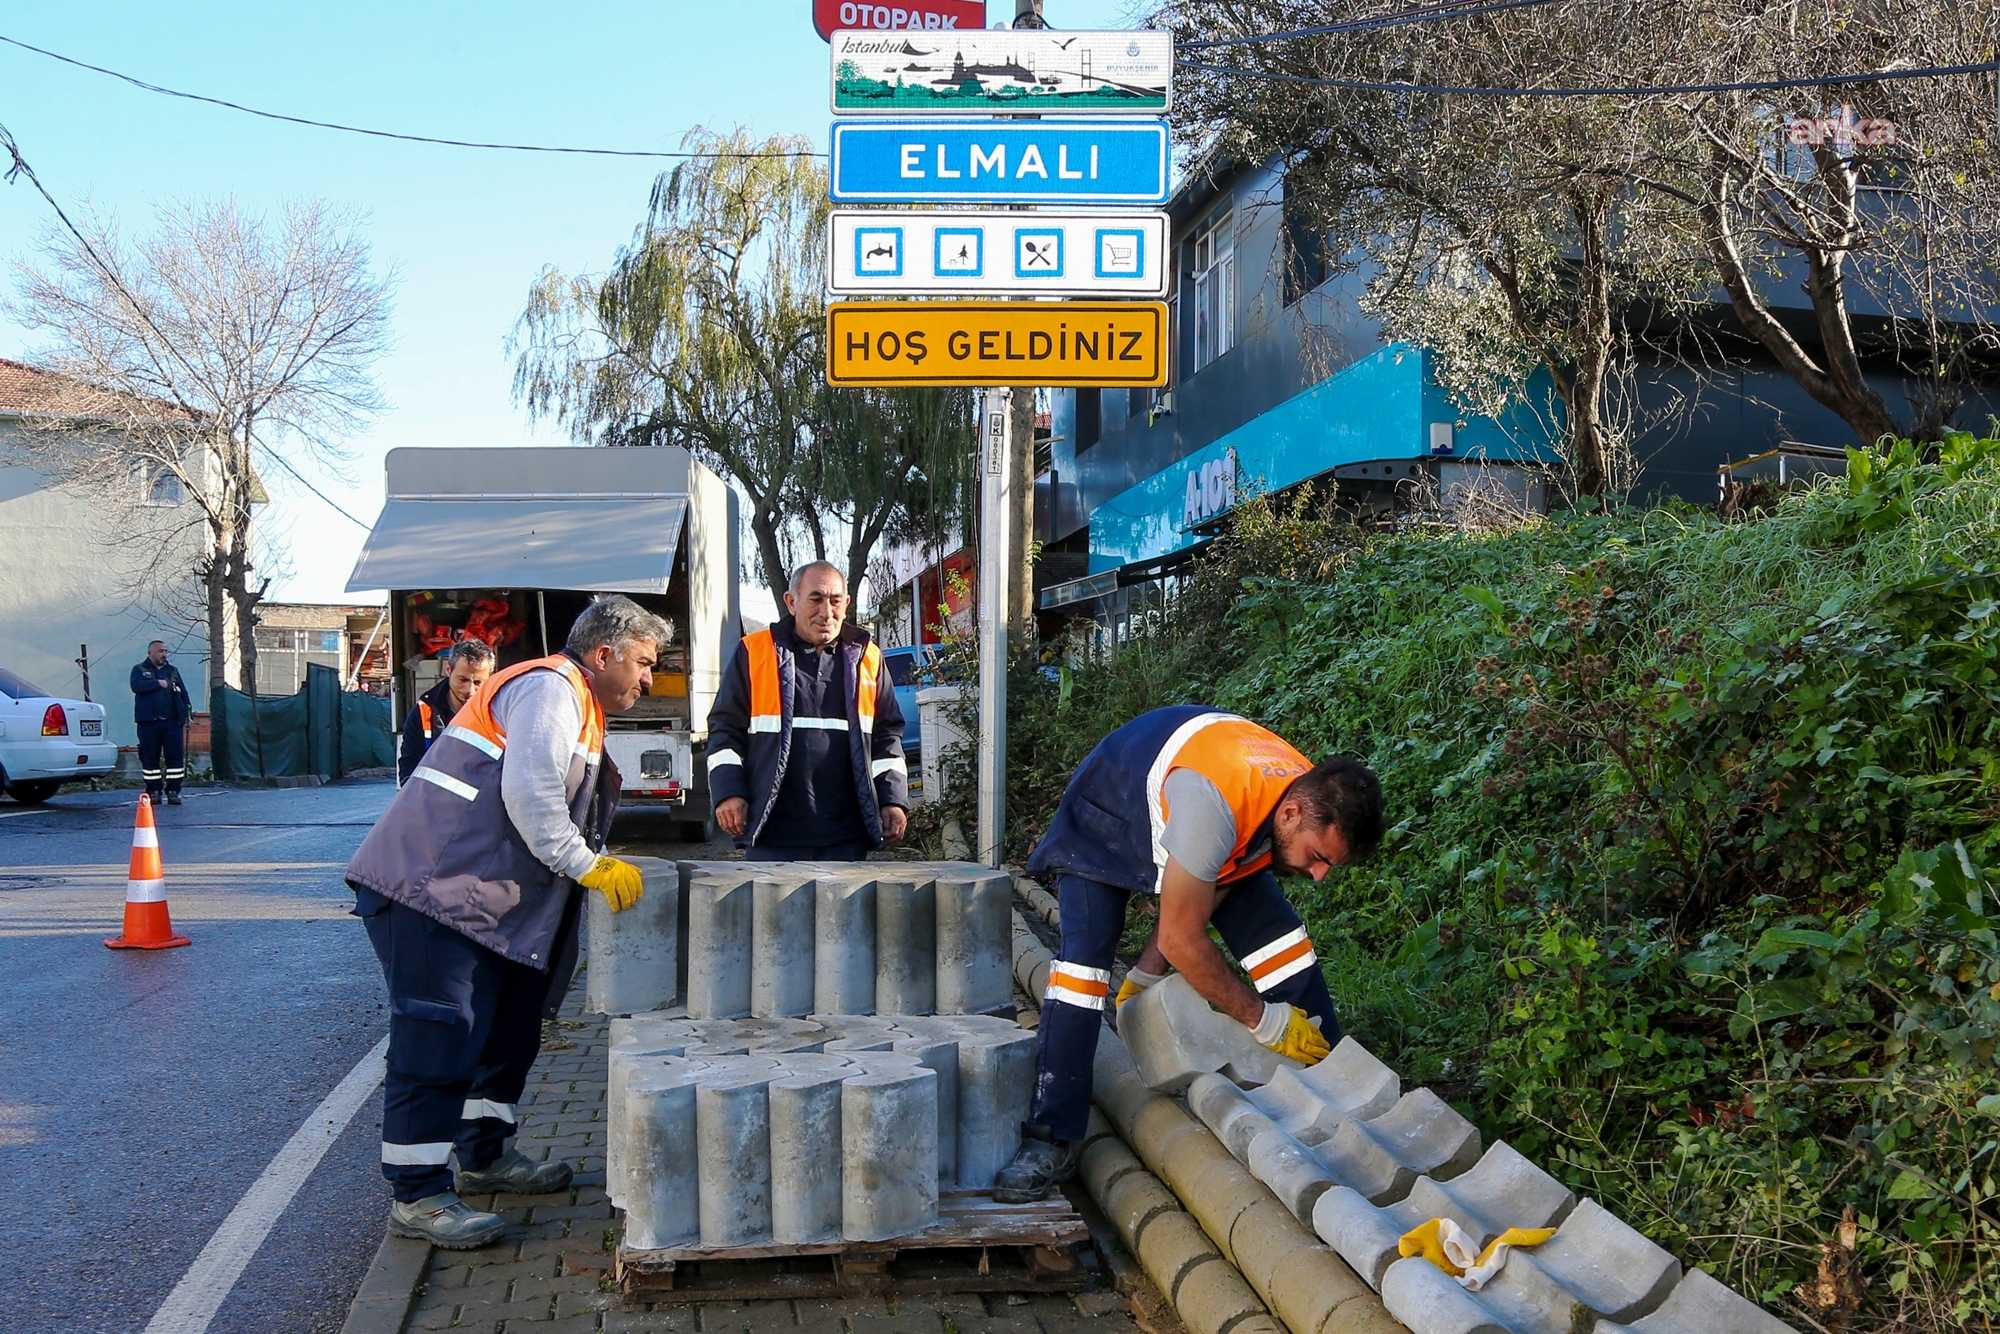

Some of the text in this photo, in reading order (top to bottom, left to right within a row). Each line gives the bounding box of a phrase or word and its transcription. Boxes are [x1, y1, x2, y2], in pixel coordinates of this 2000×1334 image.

[840, 2, 958, 30] OTOPARK
[900, 144, 1098, 179] ELMALI
[846, 323, 1142, 365] HOŞ GELDİNİZ
